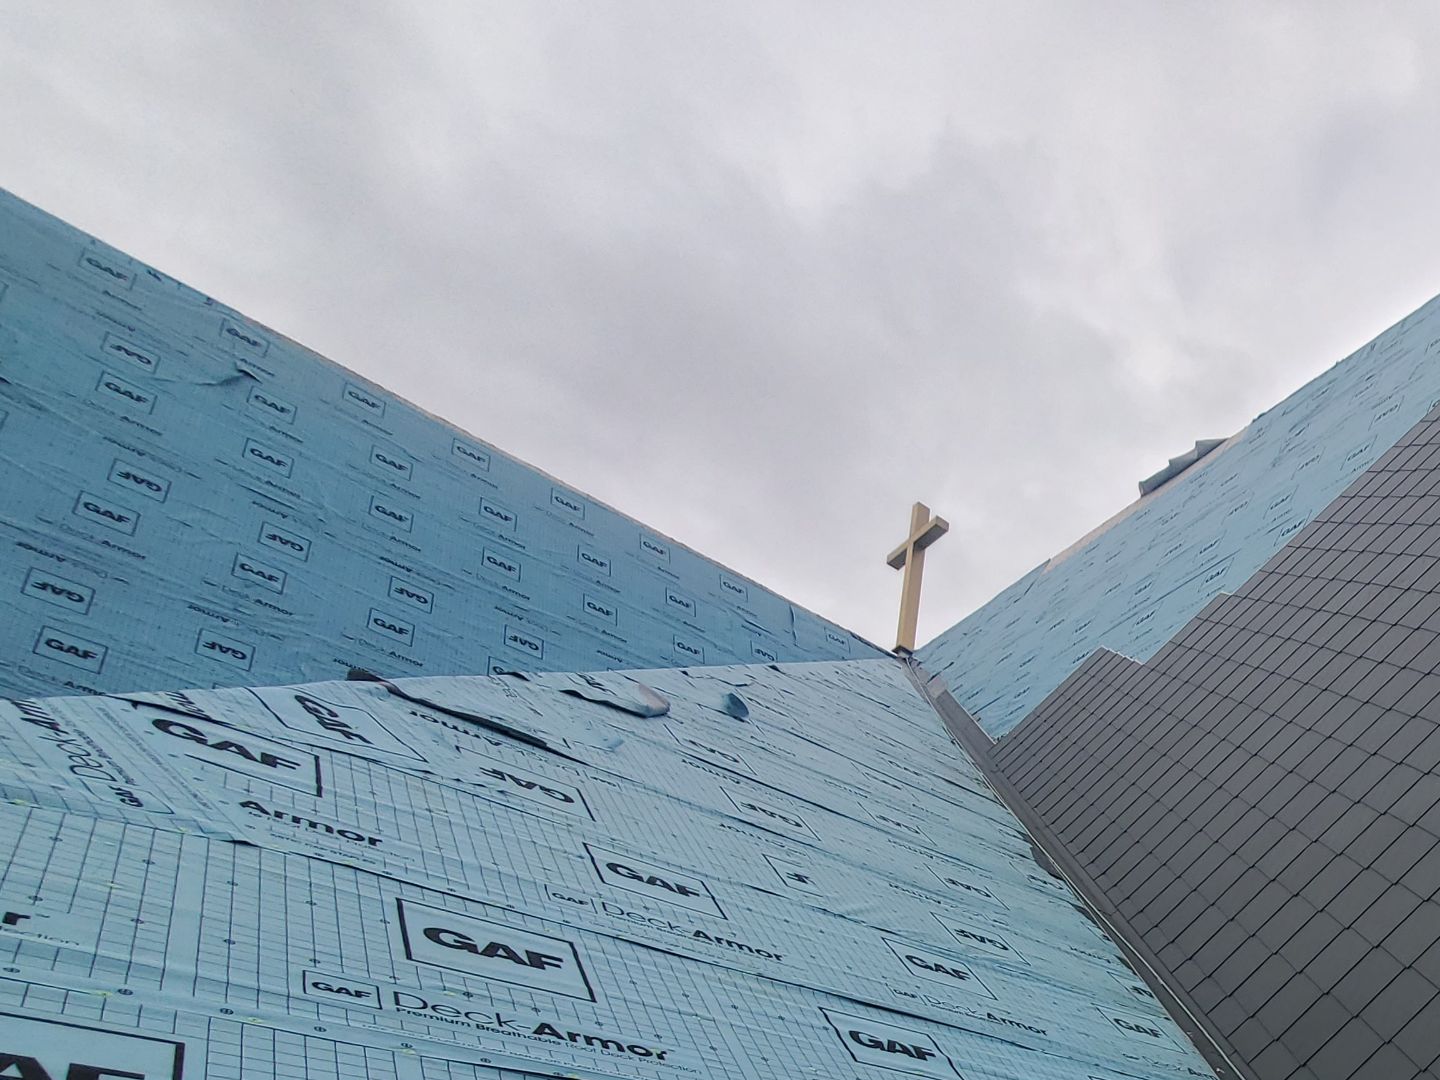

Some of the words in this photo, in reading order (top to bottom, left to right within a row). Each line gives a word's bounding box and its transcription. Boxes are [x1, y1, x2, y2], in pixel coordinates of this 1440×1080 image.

[105, 382, 149, 403] GAF
[250, 448, 288, 467] GAF
[375, 453, 408, 471] GAF
[117, 471, 162, 492] GAF
[83, 502, 131, 523] GAF
[484, 506, 513, 522] GAF
[555, 496, 580, 511] GAF
[265, 533, 304, 552] GAF
[239, 563, 279, 583] GAF
[486, 555, 517, 573] GAF
[31, 581, 85, 603] GAF
[393, 587, 428, 604] GAF
[374, 618, 409, 636] GAF
[44, 638, 98, 660] GAF
[203, 641, 247, 661] GAF
[508, 635, 539, 651] GAF
[152, 718, 301, 770] GAF
[479, 766, 575, 804] GAF
[240, 800, 383, 847] Armor
[605, 861, 701, 898] GAF
[601, 901, 784, 962] Deck-Armor
[423, 927, 564, 971] GAF
[905, 954, 971, 981] GAF
[311, 982, 372, 999] GAF
[393, 991, 669, 1061] Deck-Armor
[395, 1007, 471, 1028] Premium
[475, 1023, 561, 1045] Breathable
[1113, 1018, 1162, 1038] GAF
[848, 1029, 937, 1062] GAF
